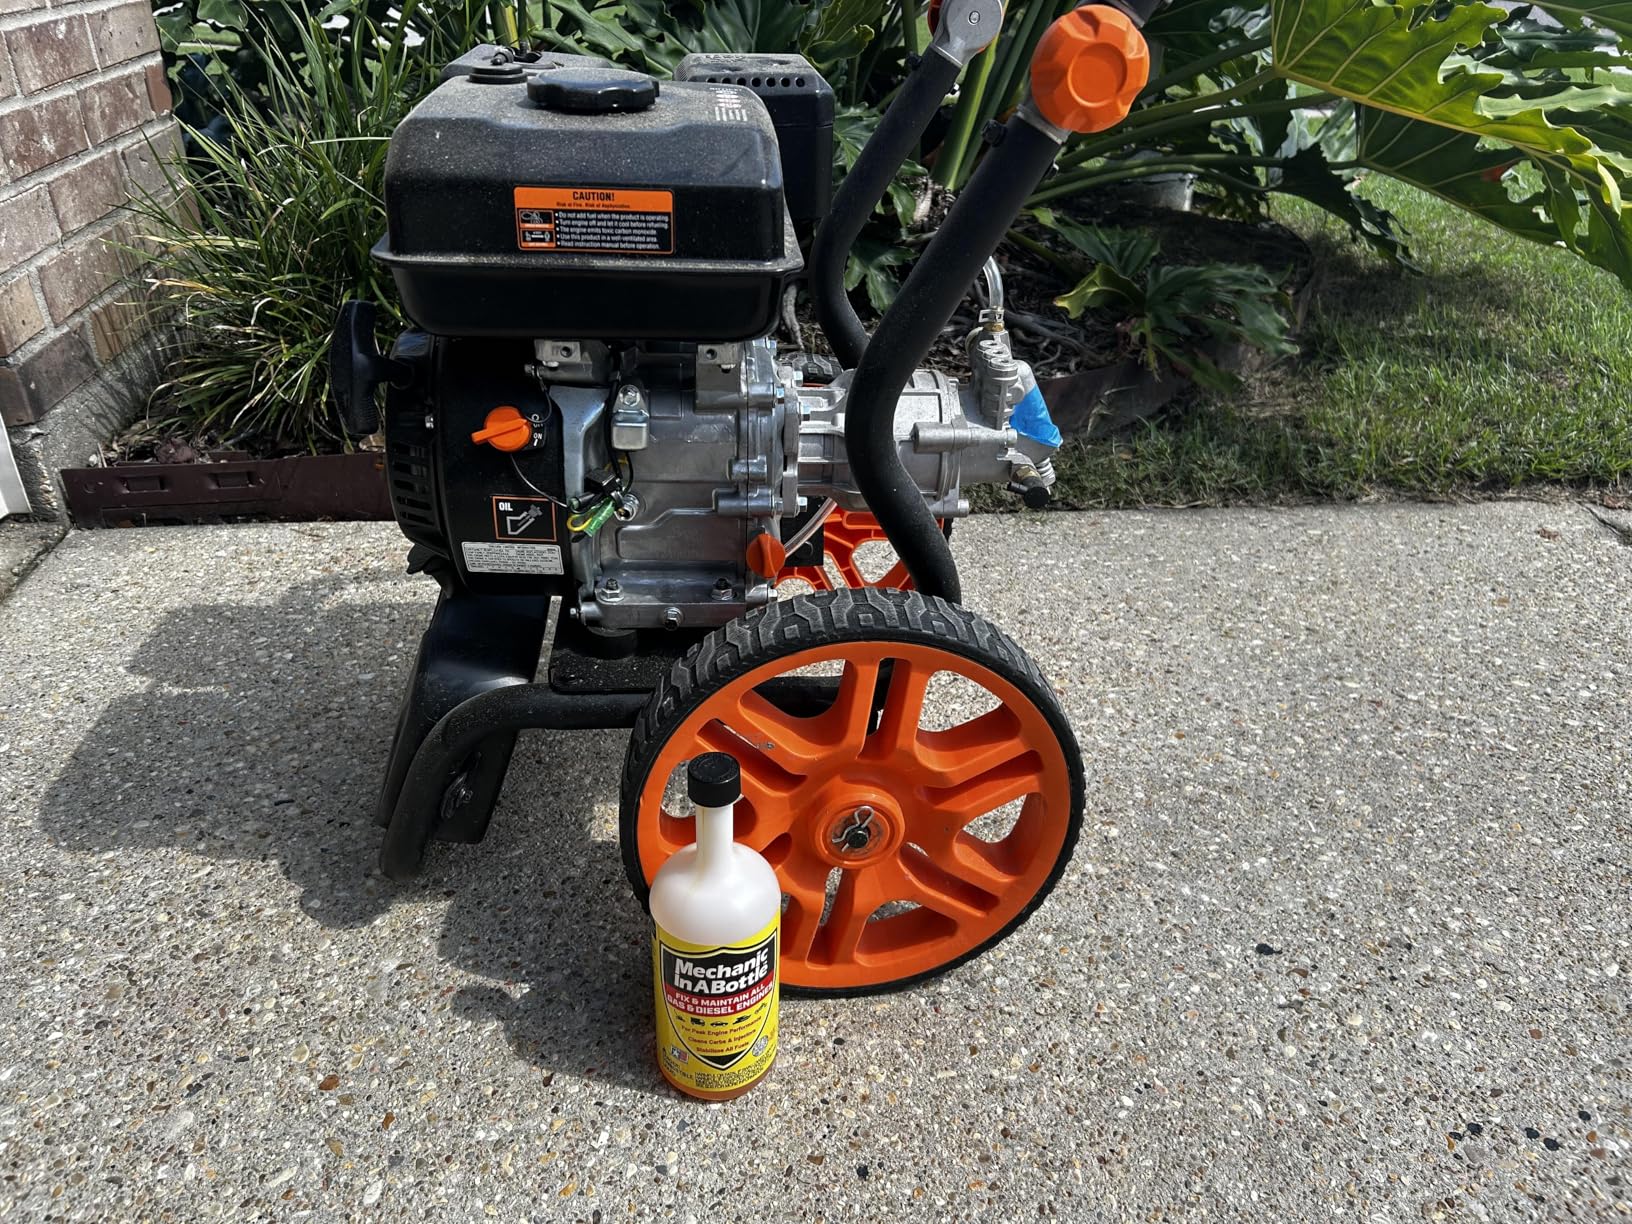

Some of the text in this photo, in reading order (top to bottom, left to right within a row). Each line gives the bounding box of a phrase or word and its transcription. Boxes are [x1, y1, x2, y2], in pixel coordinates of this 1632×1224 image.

[573, 191, 615, 201] CAUTION!
[620, 213, 639, 221] product
[499, 502, 514, 511] OIL
[675, 947, 769, 979] Mechanic
[675, 984, 766, 1007] FIX & MAINTAIN ALL
[667, 994, 685, 1009] GAS
[686, 1003, 695, 1012] &
[695, 1004, 735, 1015] DIESEL
[688, 1036, 708, 1044] Cleans
[733, 1029, 756, 1041] Injectors
[734, 1041, 749, 1050] Fuels
